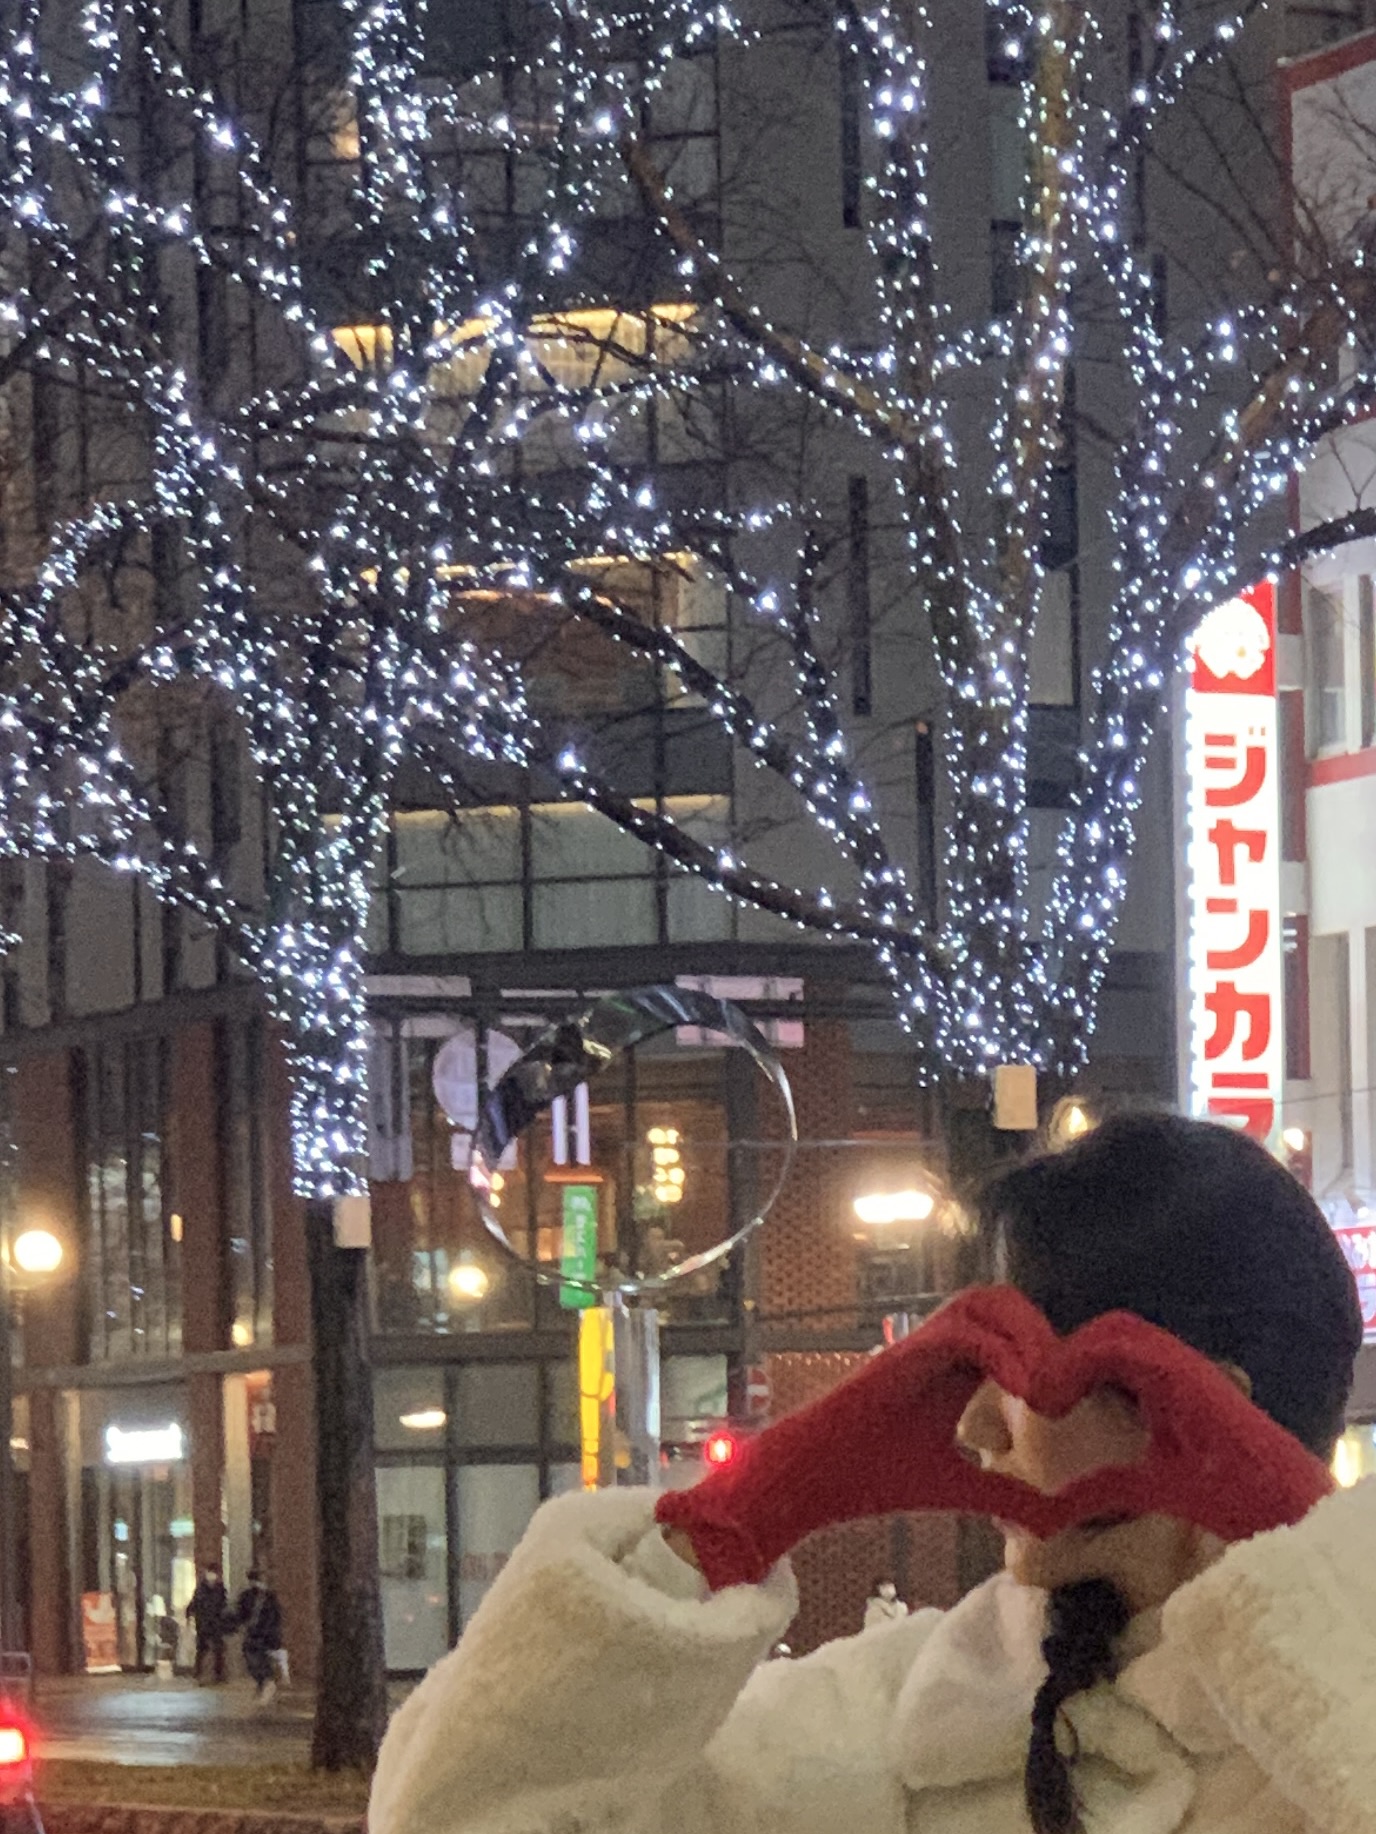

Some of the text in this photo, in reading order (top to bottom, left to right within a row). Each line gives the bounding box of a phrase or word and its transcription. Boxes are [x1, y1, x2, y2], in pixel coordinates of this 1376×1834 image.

[1204, 725, 1275, 1141] ジャンカラ
